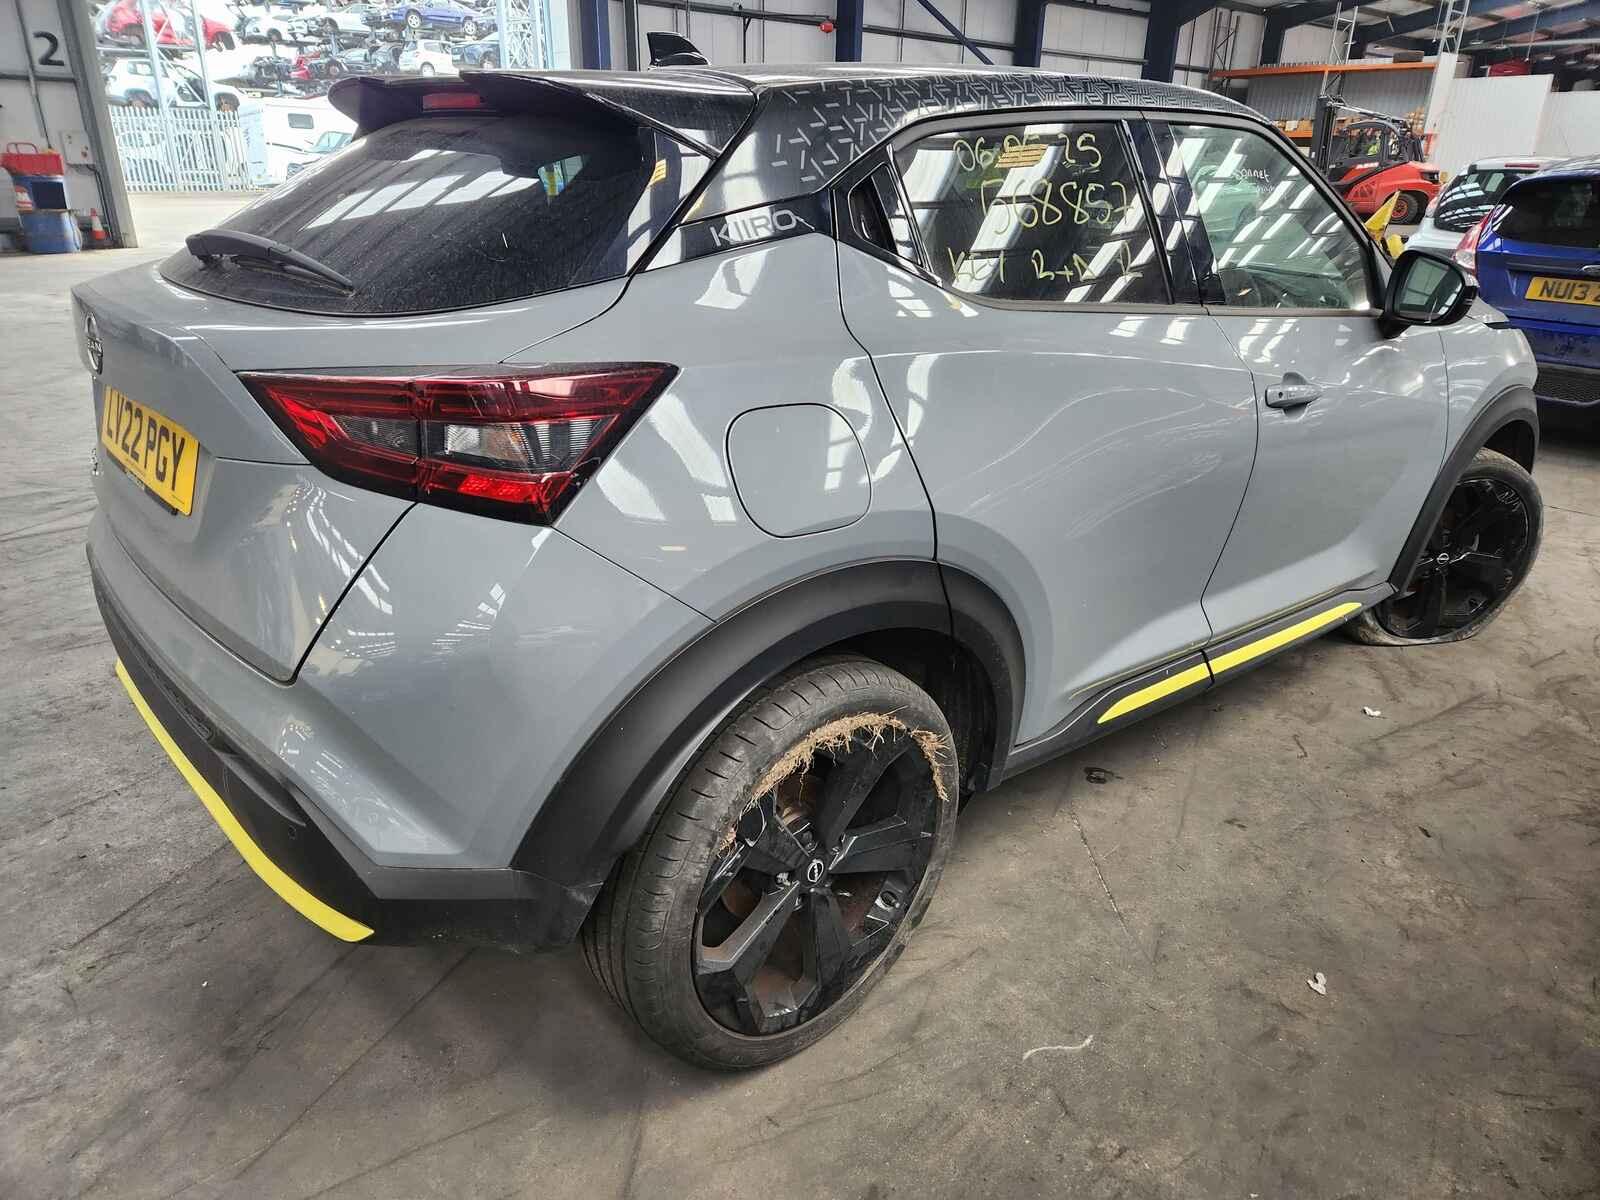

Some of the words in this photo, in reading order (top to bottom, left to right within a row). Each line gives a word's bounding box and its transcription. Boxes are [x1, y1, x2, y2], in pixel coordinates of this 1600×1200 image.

[33, 31, 65, 66] 2
[953, 138, 995, 171] 06
[709, 208, 798, 247] KIIRO
[1538, 280, 1590, 300] NU13
[106, 388, 143, 463] LV22
[144, 415, 186, 491] PGY
